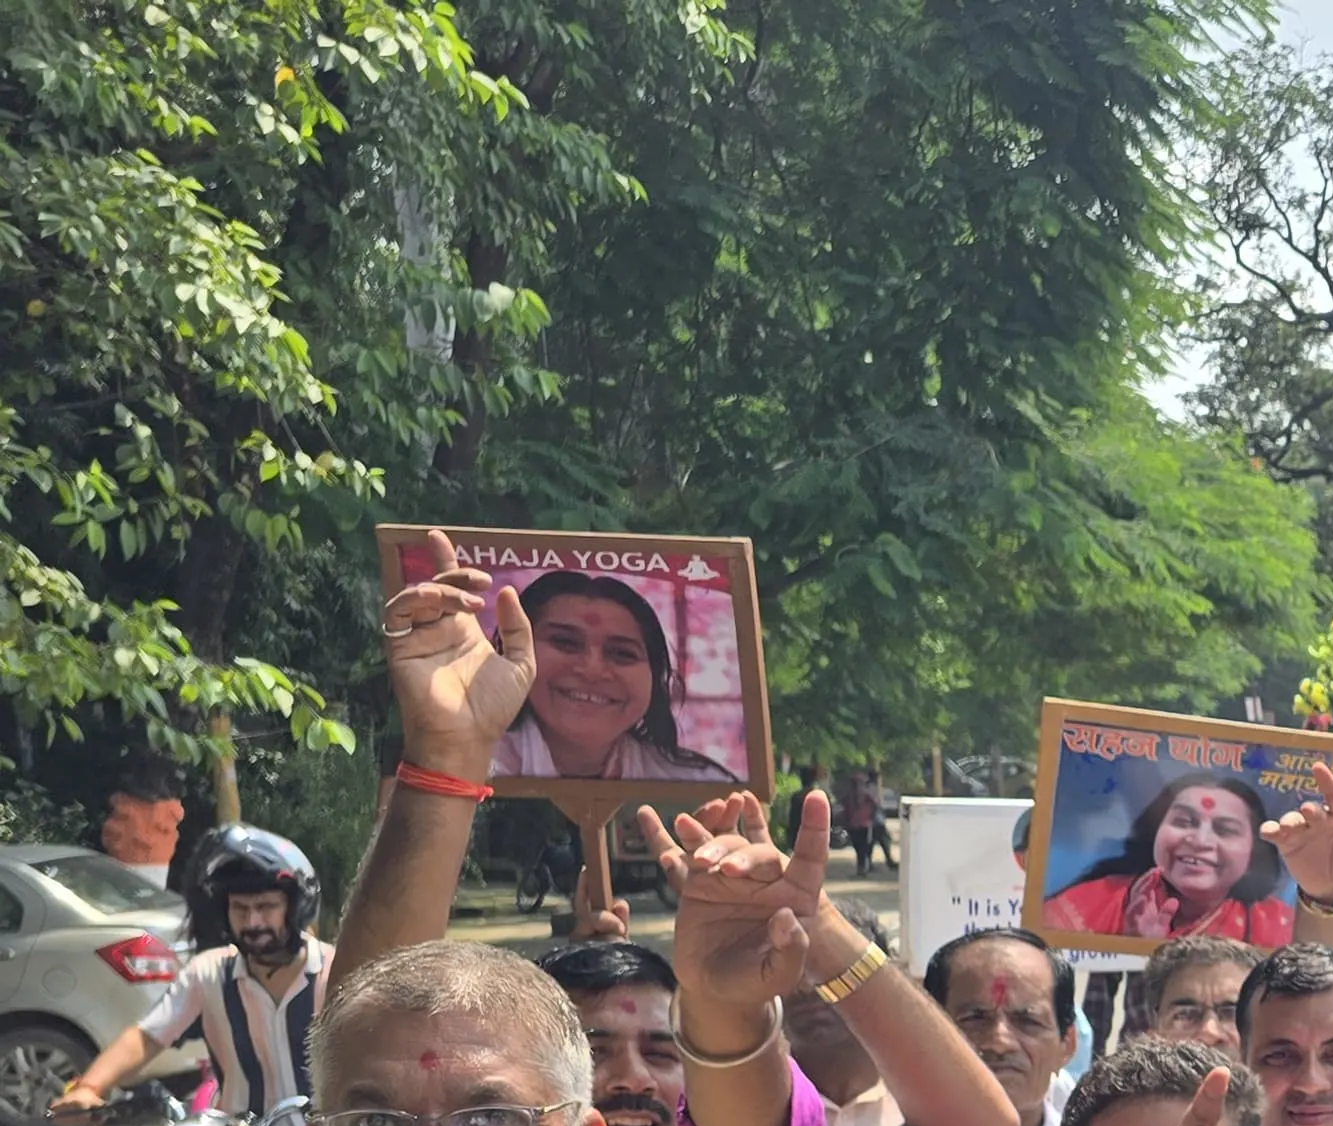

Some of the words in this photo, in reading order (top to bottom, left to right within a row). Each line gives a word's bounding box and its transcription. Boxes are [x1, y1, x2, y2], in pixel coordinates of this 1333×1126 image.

[455, 543, 565, 570] AHAJA
[572, 548, 670, 574] YOGA
[1062, 723, 1160, 763] सहज
[1168, 735, 1247, 773] योग
[986, 898, 1001, 917] is
